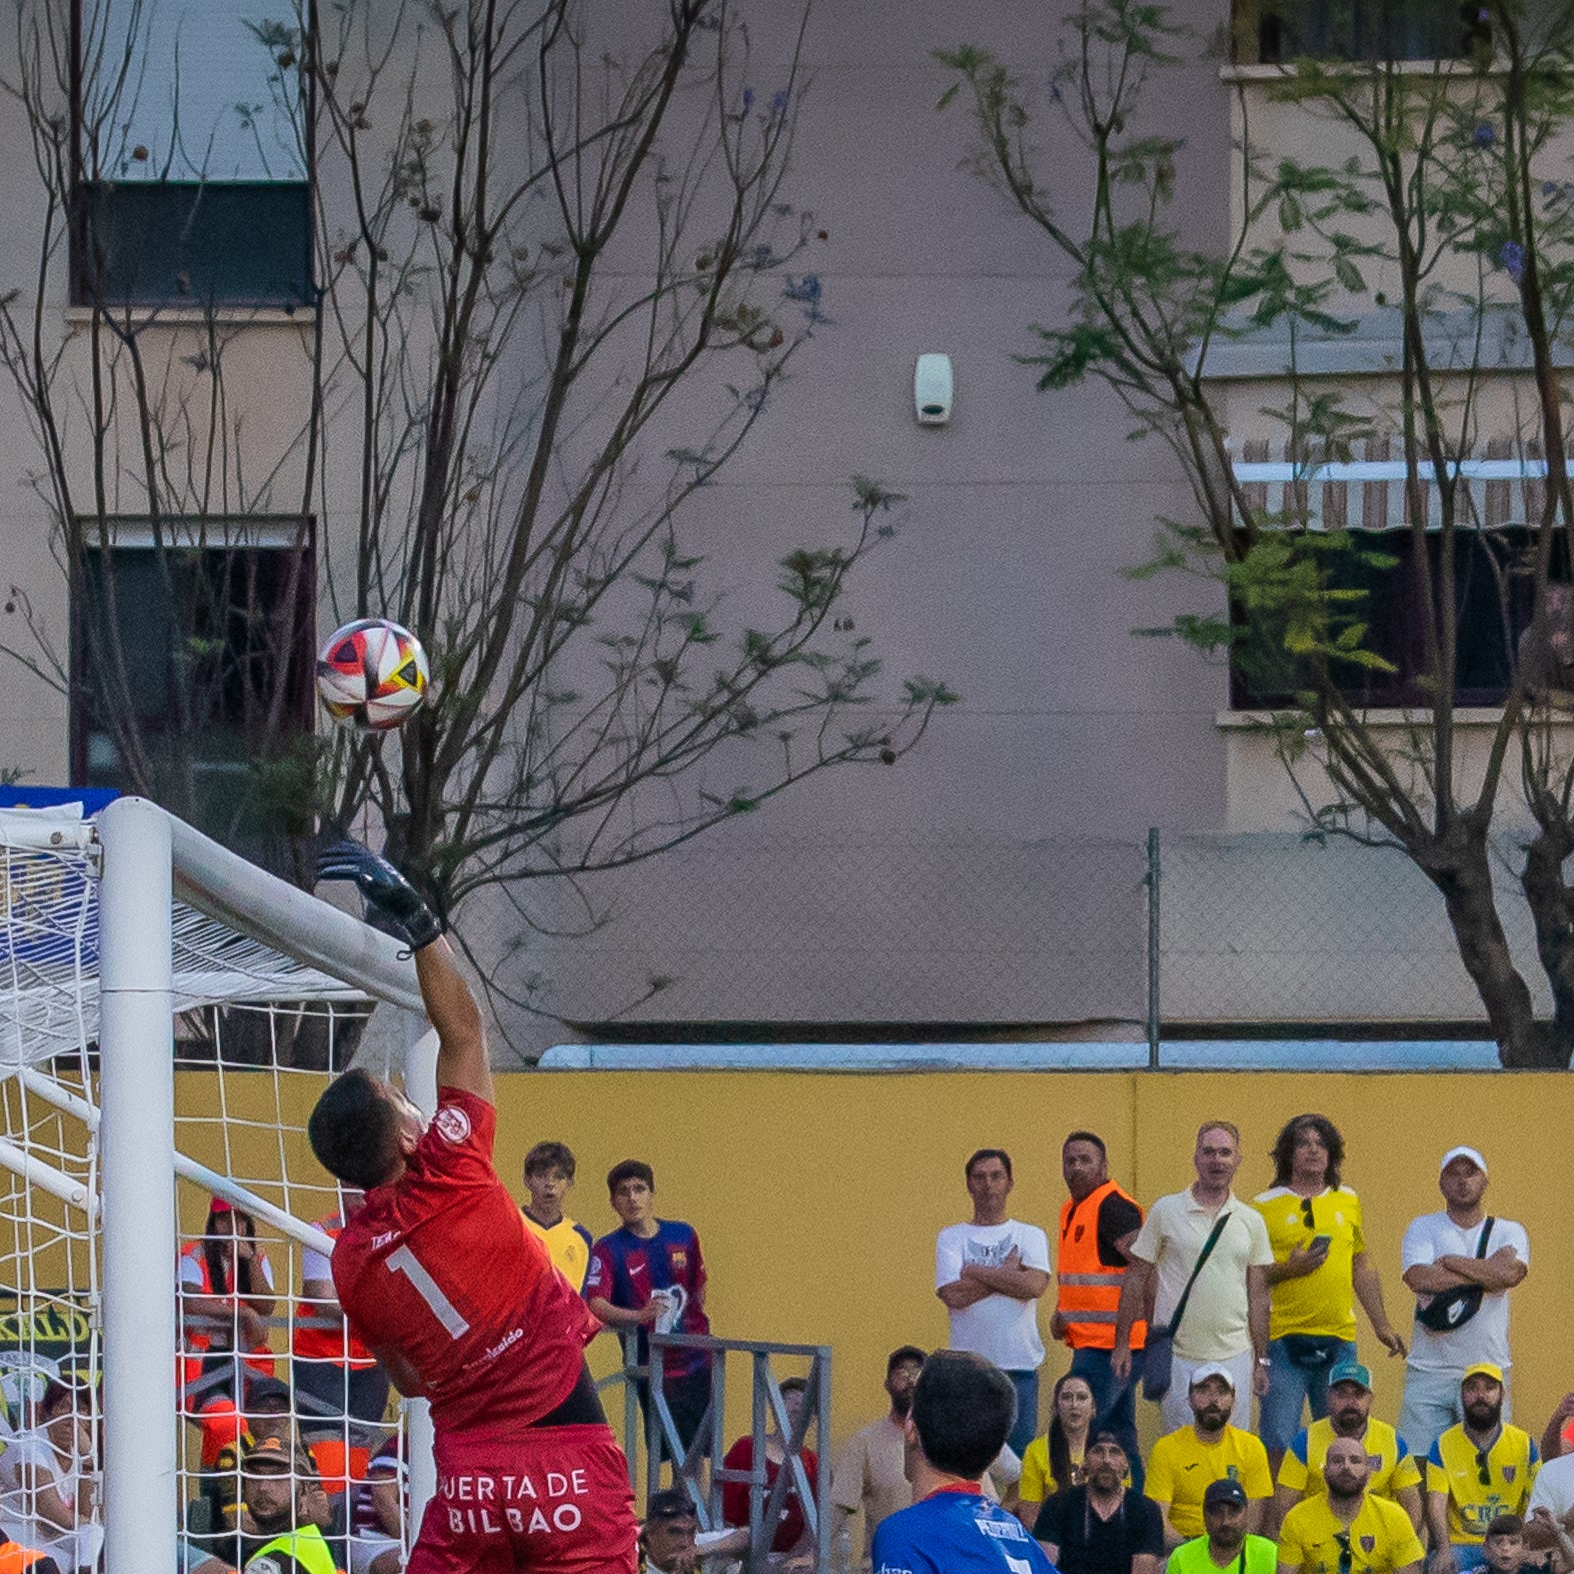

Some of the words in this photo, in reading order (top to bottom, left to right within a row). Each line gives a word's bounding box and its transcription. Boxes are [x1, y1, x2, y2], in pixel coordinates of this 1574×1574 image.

[385, 1244, 470, 1340] 1
[546, 1469, 589, 1498] DE
[448, 1503, 582, 1534] BILBAO
